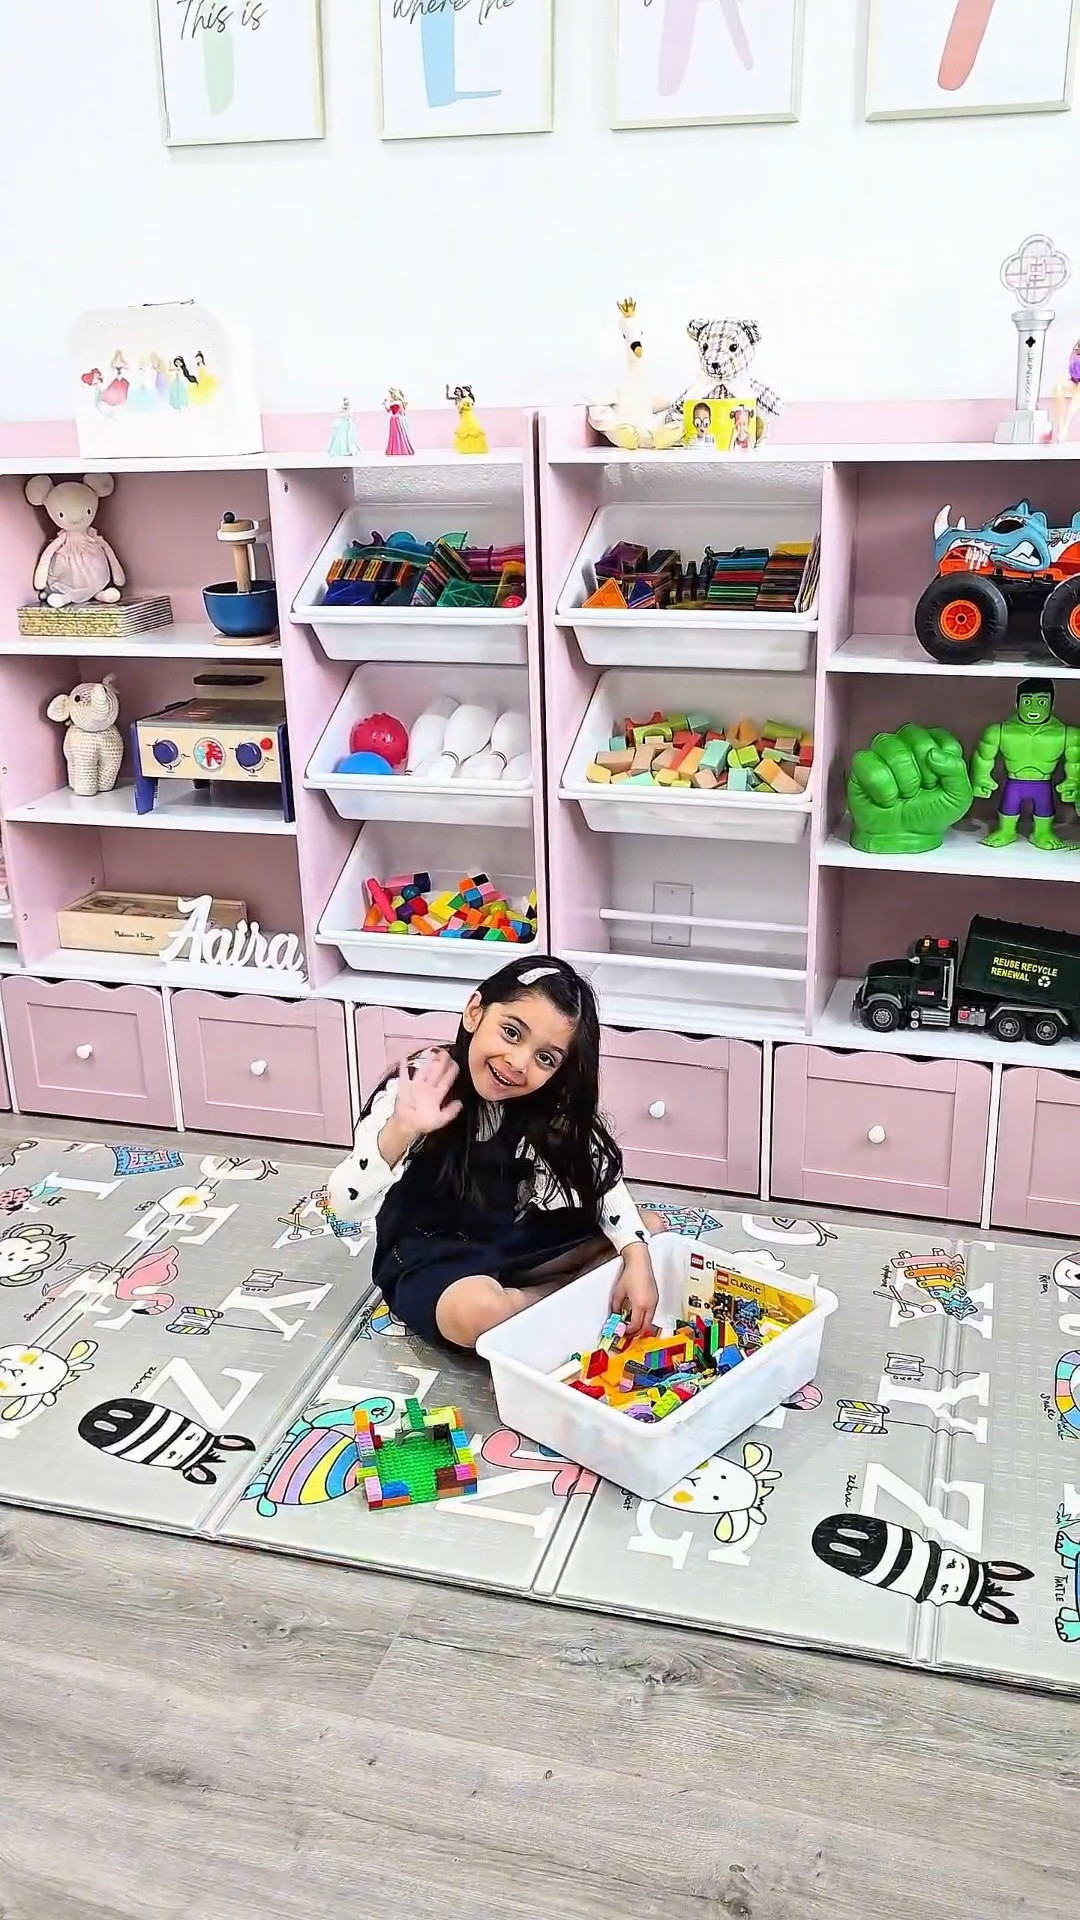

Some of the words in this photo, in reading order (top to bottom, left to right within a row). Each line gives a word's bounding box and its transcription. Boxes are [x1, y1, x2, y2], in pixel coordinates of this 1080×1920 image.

[176, 0, 234, 40] This
[241, 1, 268, 31] is
[158, 894, 307, 974] Aaira
[990, 966, 1030, 982] RENEWAL
[992, 956, 1020, 970] REUSE
[1020, 962, 1059, 977] RECYCLE
[730, 1278, 761, 1295] CLASSIC
[846, 1473, 858, 1508] zebra
